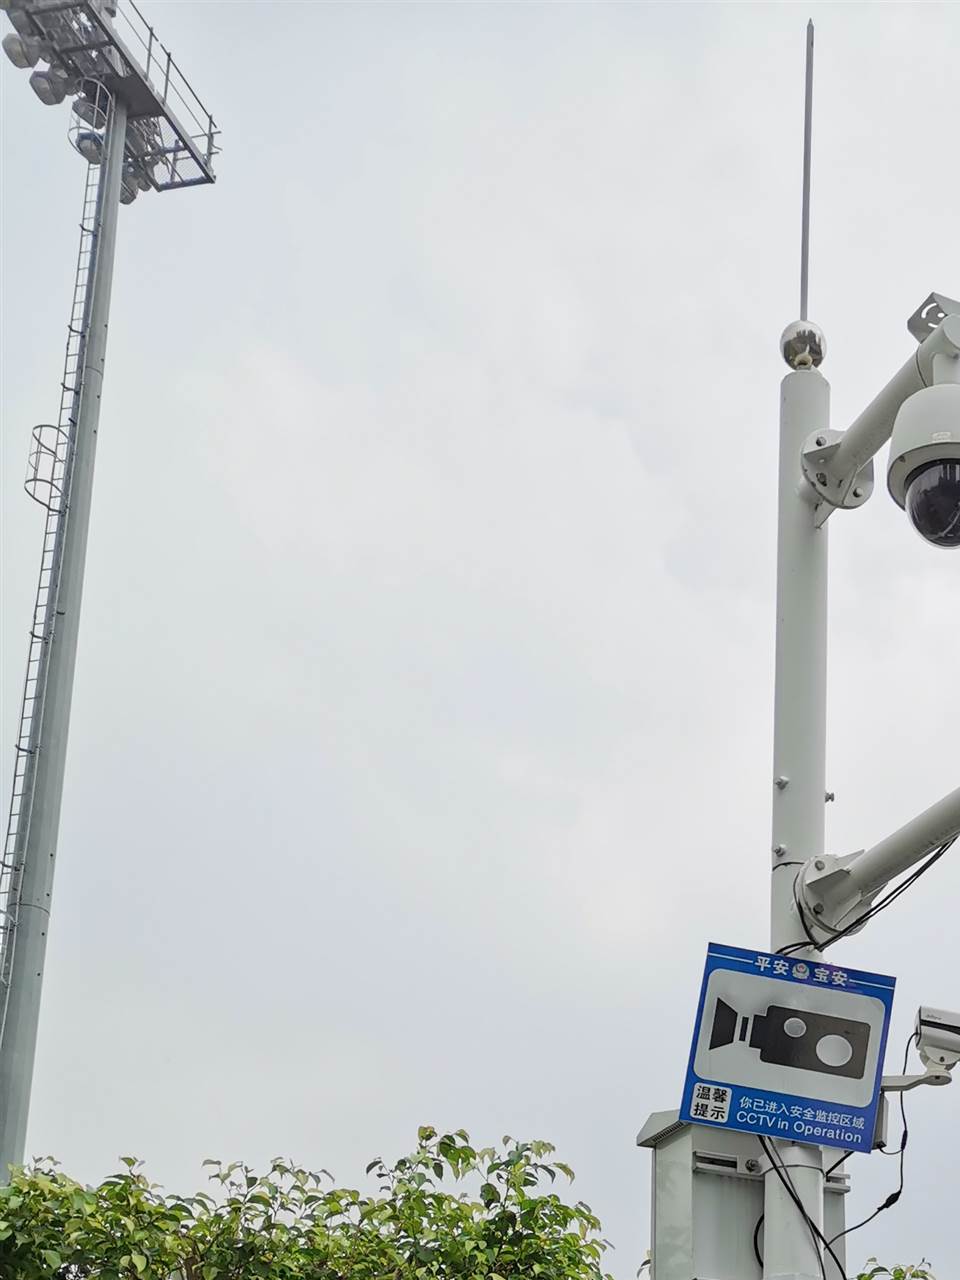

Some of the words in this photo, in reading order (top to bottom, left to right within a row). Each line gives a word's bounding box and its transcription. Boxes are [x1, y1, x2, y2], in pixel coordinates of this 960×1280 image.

[755, 955, 790, 976] 平安
[813, 967, 848, 987] 宝安
[696, 1085, 728, 1104] 温馨
[693, 1102, 726, 1120] 提示
[736, 1111, 776, 1127] CCTV
[778, 1117, 789, 1130] in
[793, 1121, 862, 1143] Operation
[739, 1096, 865, 1129] 你已进入安全监控区域
